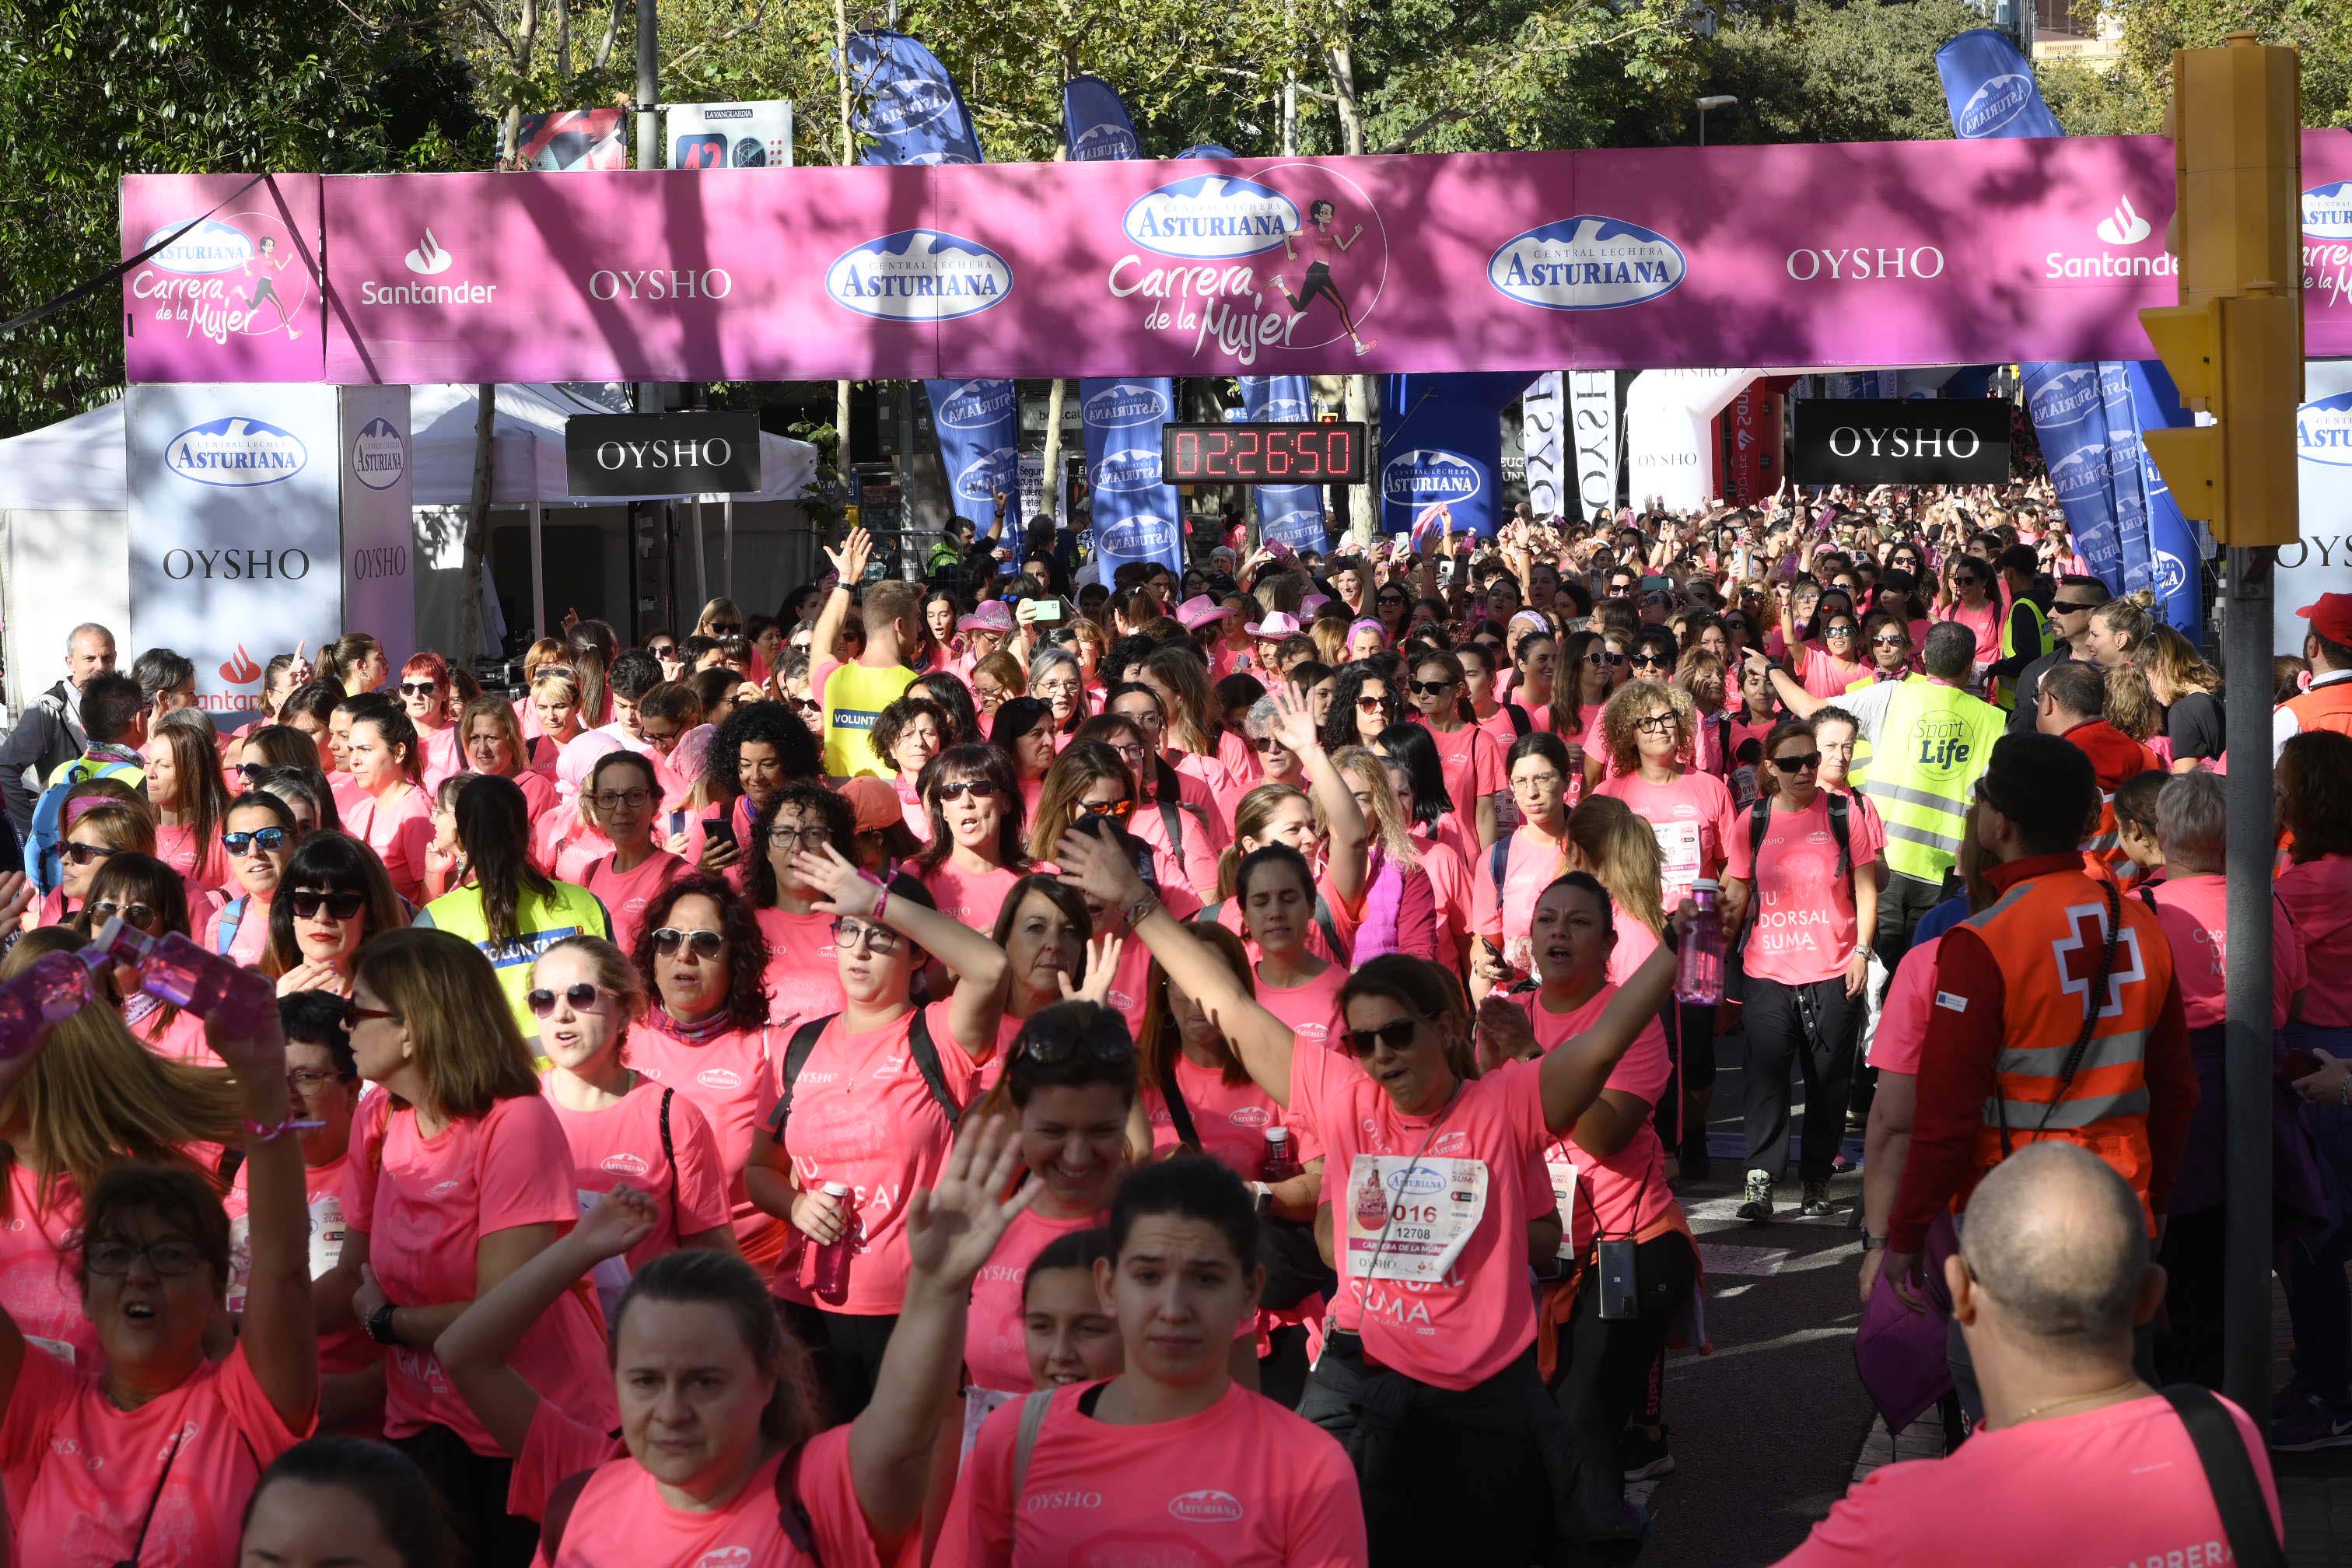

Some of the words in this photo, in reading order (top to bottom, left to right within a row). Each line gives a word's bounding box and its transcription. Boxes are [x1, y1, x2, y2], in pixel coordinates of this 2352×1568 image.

[1138, 205, 1286, 238] ASTURIANA
[1534, 248, 1595, 259] CENTRAL
[1601, 247, 1664, 257] LECHERA
[1786, 246, 1944, 281] OYSHO
[840, 264, 999, 298] ASTURIANA
[1108, 254, 1255, 298] Carrera
[1503, 251, 1671, 287] ASTURIANA
[2318, 267, 2333, 289] la
[133, 270, 225, 299] Carrera
[362, 281, 497, 306] Santander
[589, 268, 733, 300] OYSHO
[156, 300, 173, 320] de
[176, 300, 188, 320] la
[186, 297, 259, 345] Mujer
[1144, 299, 1171, 331] de
[1178, 299, 1197, 331] la
[1192, 292, 1309, 366] Mujer
[176, 442, 298, 469] ASTURIANA
[597, 437, 732, 470] OYSHO
[1177, 432, 1349, 474] 02:26:50
[1829, 426, 1979, 458] OYSHO
[357, 444, 402, 472] ASTURIANA
[1638, 451, 1698, 467] OYSHO
[1020, 488, 1045, 497] quiere
[1383, 472, 1473, 494] ASTURIANA
[163, 548, 310, 580] OYSHO
[354, 545, 406, 580] OYSHO
[834, 713, 877, 726] VOLUNT
[1915, 719, 1965, 741] Sport
[1919, 738, 1970, 770] Life
[1760, 891, 1777, 906] TU
[1761, 910, 1829, 928] DORSAL
[1762, 933, 1815, 950] SUMA
[604, 1160, 646, 1172] ASTURIANA
[1393, 1206, 1437, 1223] 016
[1363, 1242, 1397, 1251] CARERA
[1396, 1228, 1430, 1240] 12708
[1350, 1280, 1431, 1325] SUMA
[1027, 1492, 1102, 1514] OYSHO
[1176, 1501, 1237, 1517] ASTURIANA
